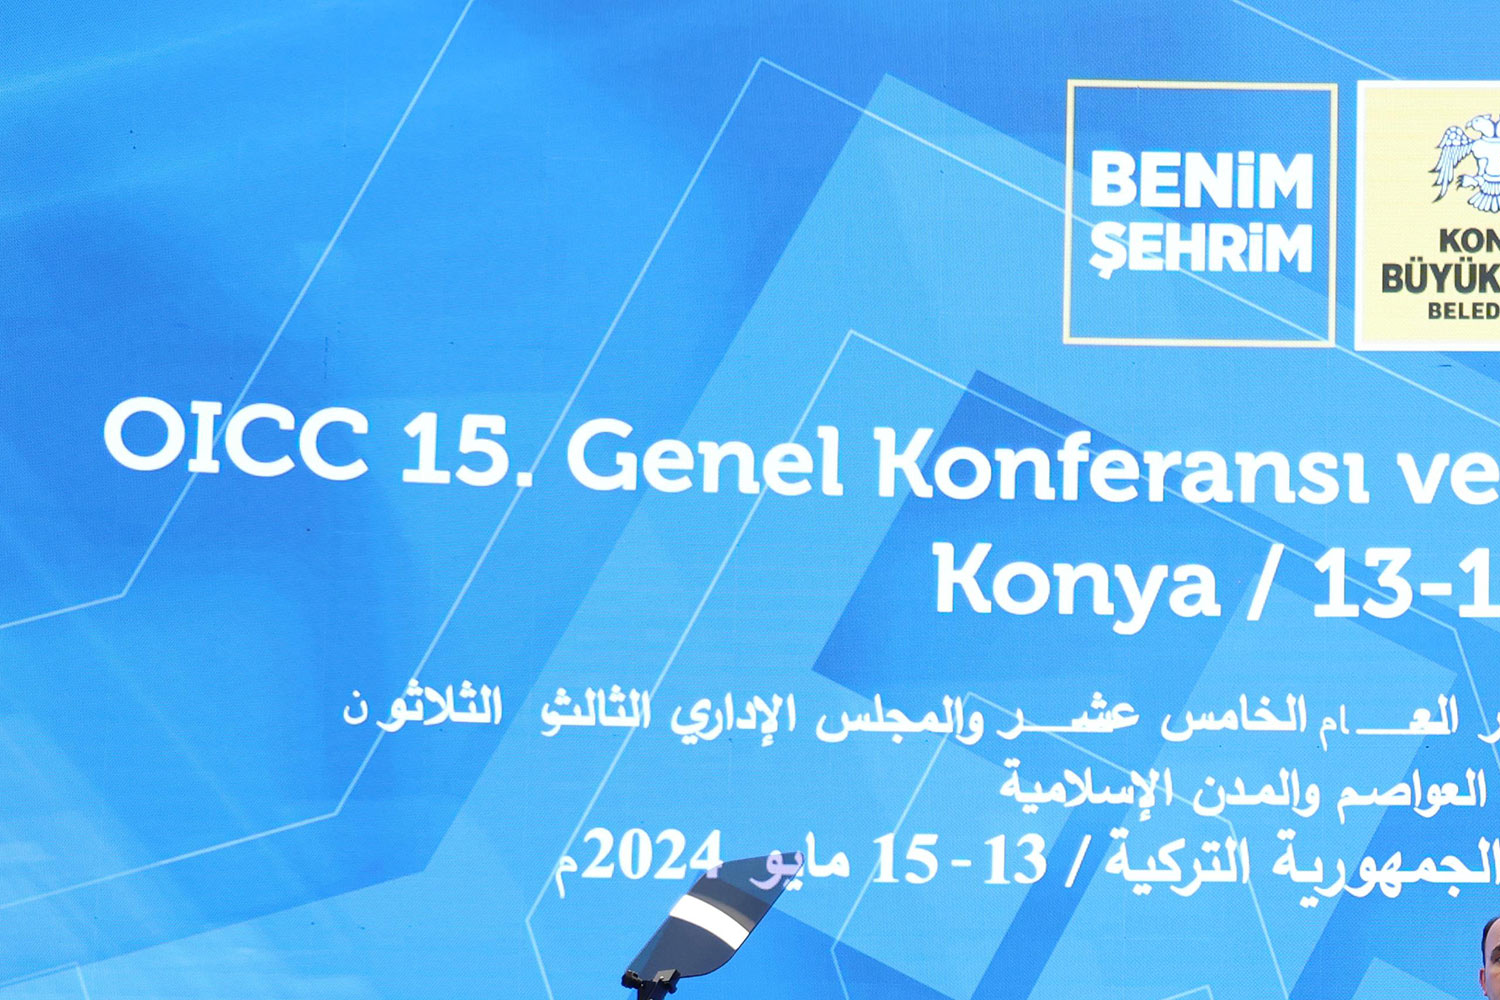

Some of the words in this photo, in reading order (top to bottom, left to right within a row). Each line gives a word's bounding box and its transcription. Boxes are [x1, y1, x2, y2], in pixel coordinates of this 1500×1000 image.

[104, 397, 368, 481] OICC
[403, 412, 533, 487] 15.
[567, 418, 844, 496] Genel
[873, 427, 1370, 505] Konferansı
[1397, 452, 1500, 505] ve
[932, 542, 1221, 635] Konya
[1247, 543, 1285, 621] /
[671, 692, 796, 747] الإداري
[815, 693, 984, 746] والمجلس
[1161, 693, 1307, 742] الخامس
[999, 758, 1174, 833] الإسلامية
[1192, 767, 1321, 818] والمدن
[1337, 767, 1487, 824] العواصم
[750, 831, 850, 891] مايو
[1065, 834, 1092, 888] /
[1105, 827, 1250, 897] التركية
